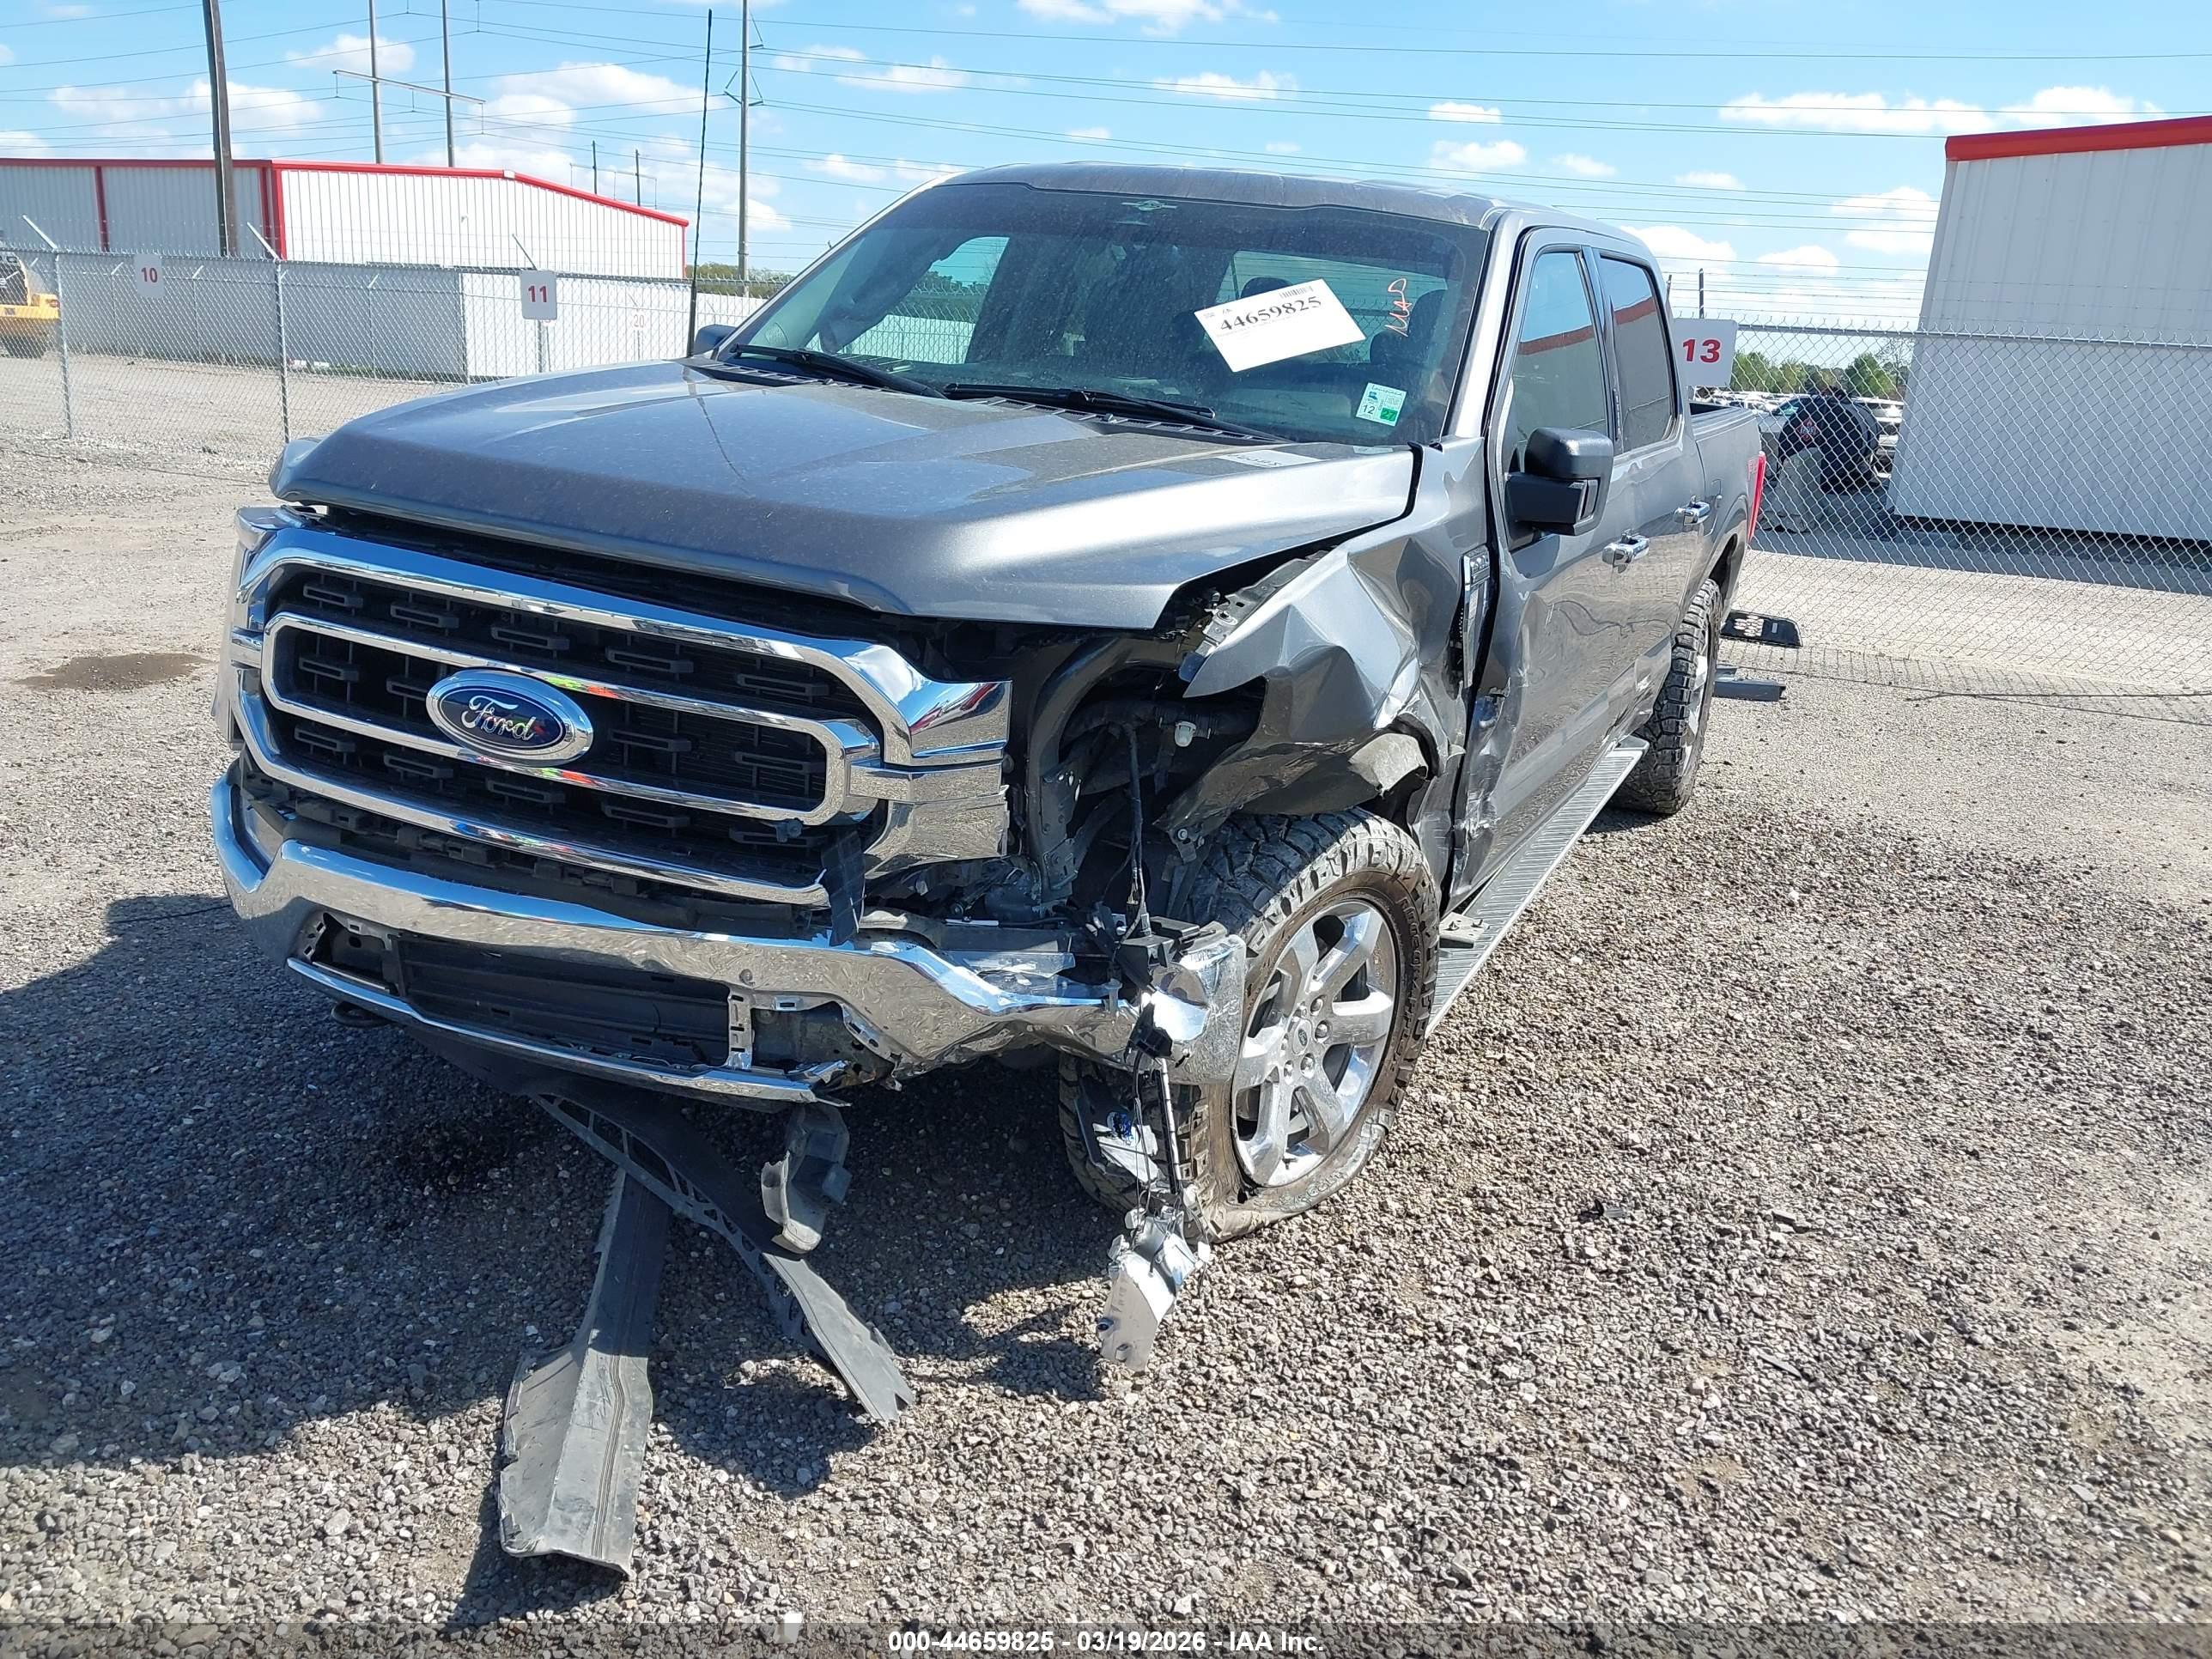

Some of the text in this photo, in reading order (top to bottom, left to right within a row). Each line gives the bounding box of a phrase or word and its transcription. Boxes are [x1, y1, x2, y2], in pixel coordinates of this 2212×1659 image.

[141, 267, 158, 283] 10
[527, 285, 548, 303] 11
[1219, 295, 1322, 331] 44659825
[1682, 338, 1722, 363] 13
[1362, 404, 1376, 415] 12
[1382, 409, 1397, 422] 27
[460, 695, 538, 742] Ford
